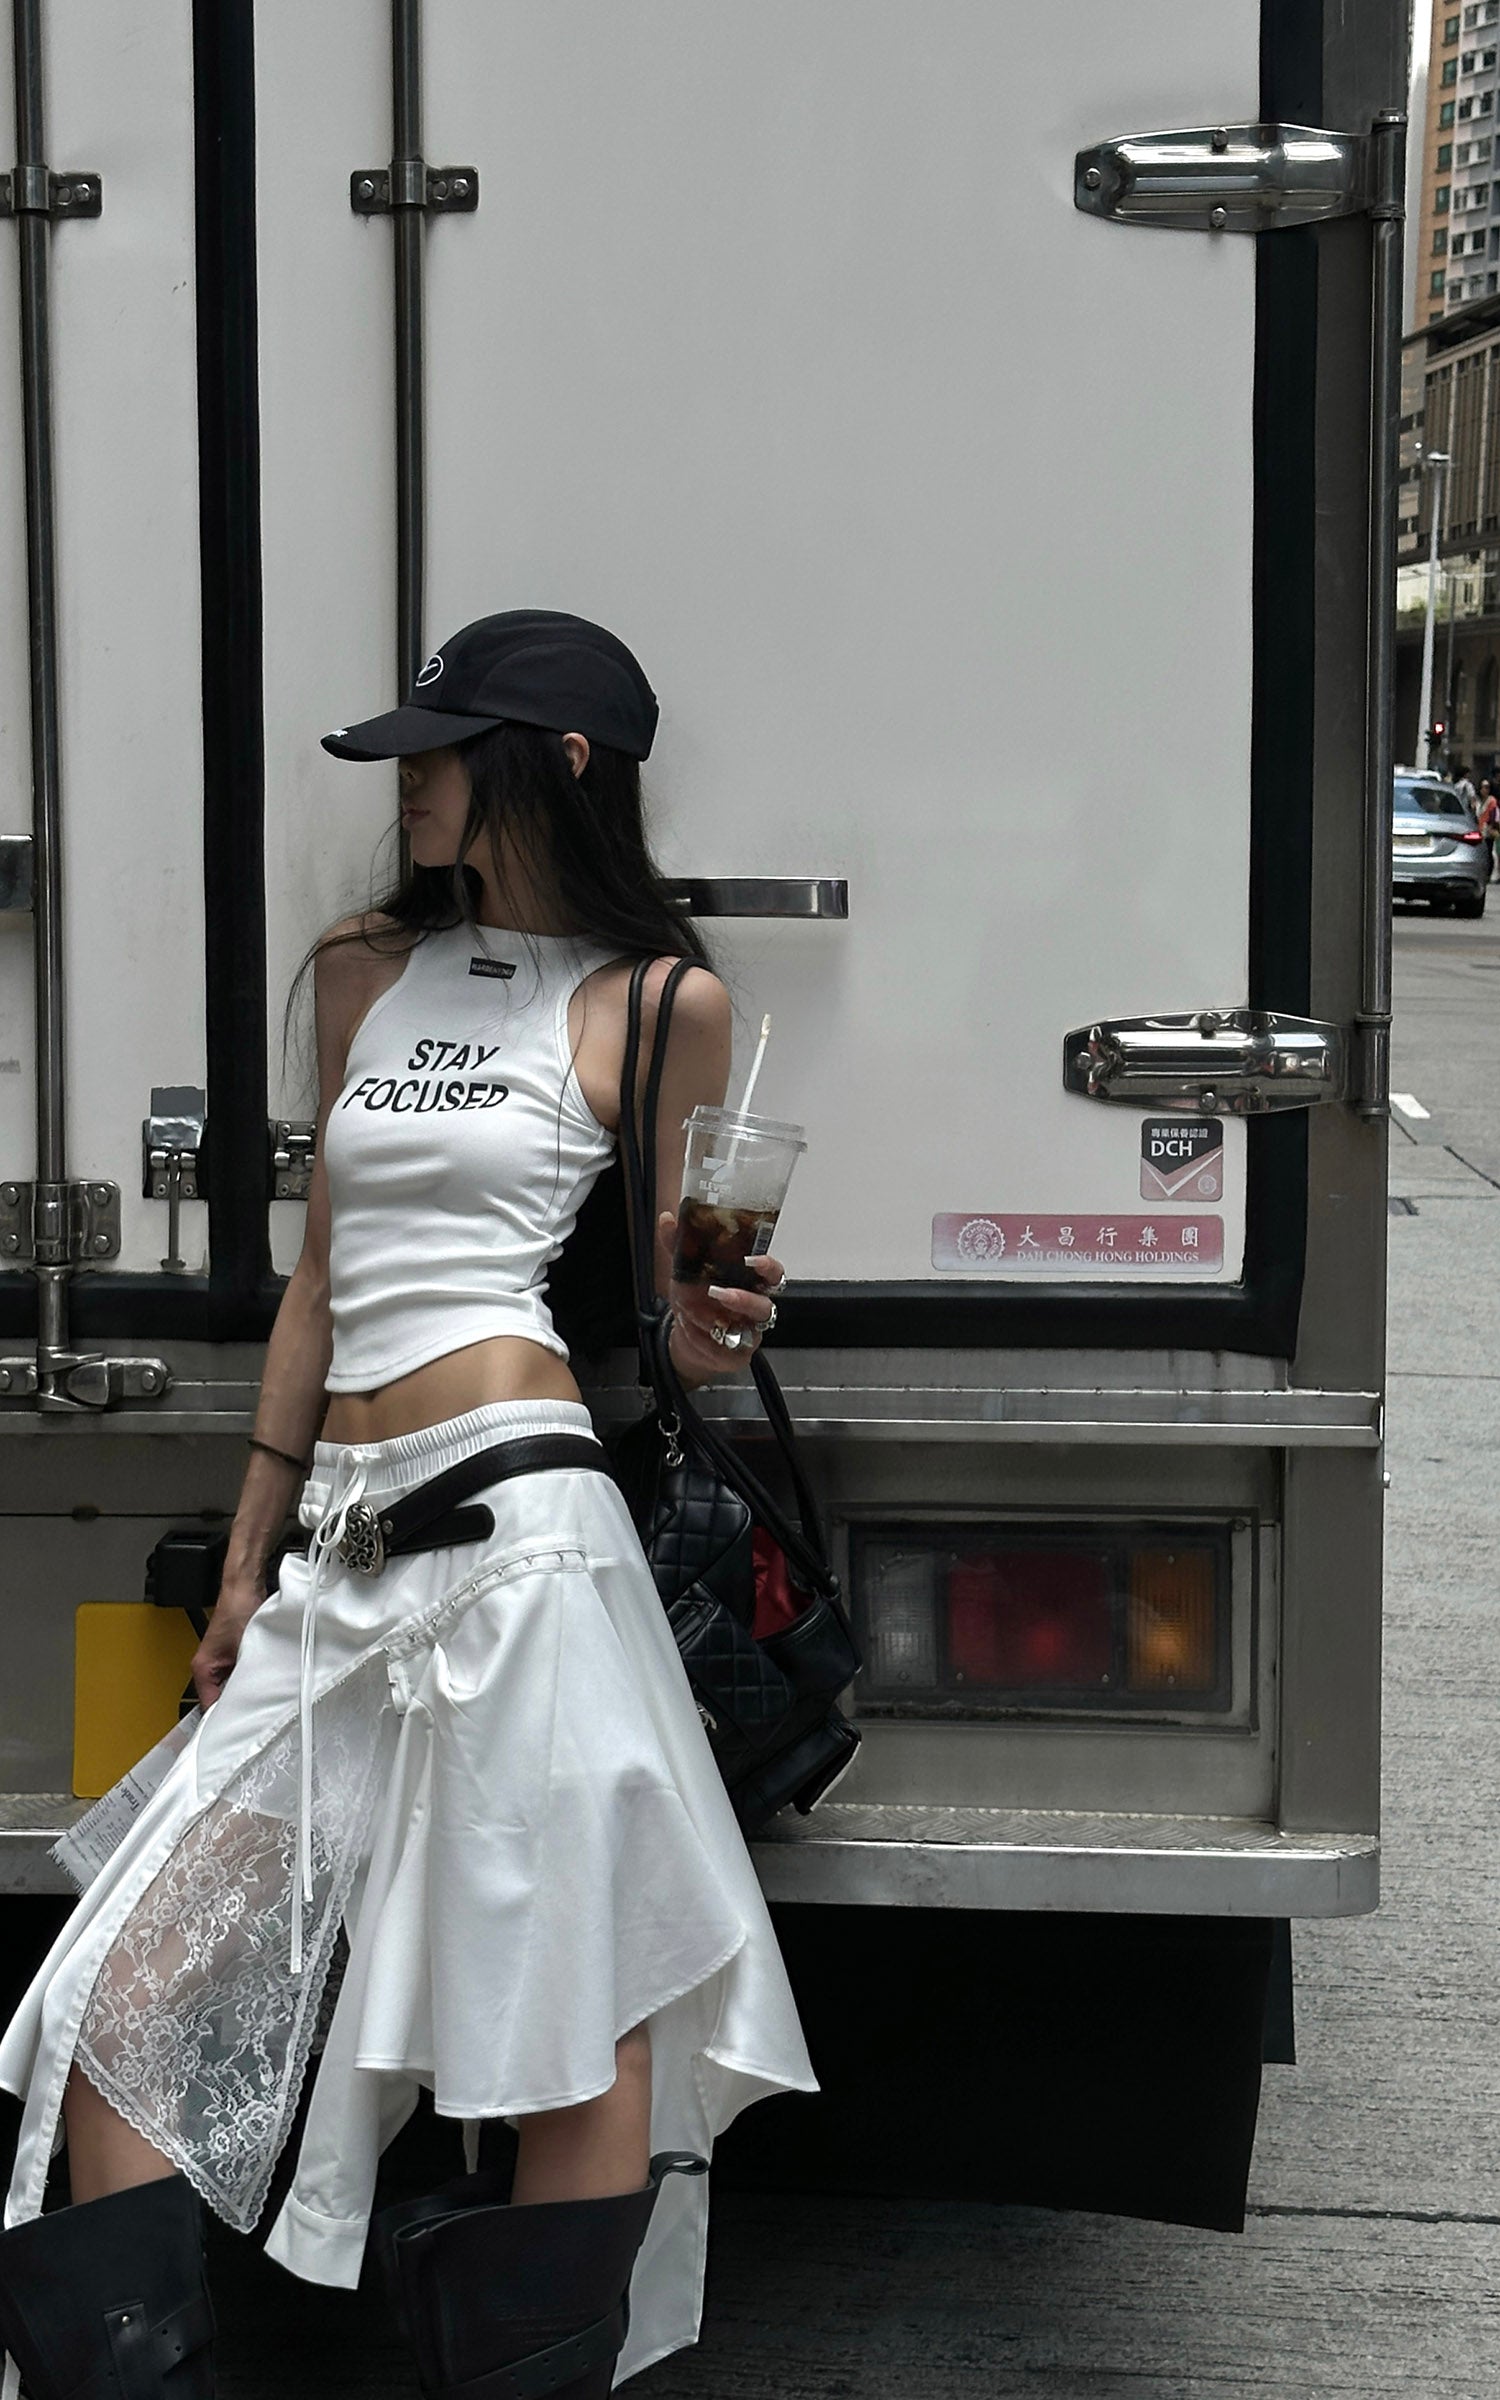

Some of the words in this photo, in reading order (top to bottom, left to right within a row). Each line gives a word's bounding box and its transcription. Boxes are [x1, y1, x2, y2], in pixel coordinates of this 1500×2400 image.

[407, 1039, 500, 1071] STAY
[342, 1078, 509, 1113] FOCUSED
[1151, 1140, 1192, 1157] DCH
[1017, 1225, 1199, 1247] 大昌行集團
[1017, 1251, 1043, 1262] DAH
[1046, 1251, 1092, 1263] CHONG
[1095, 1251, 1132, 1263] HONG
[1135, 1251, 1199, 1263] HOLDINGS
[120, 1786, 140, 1813] Trade
